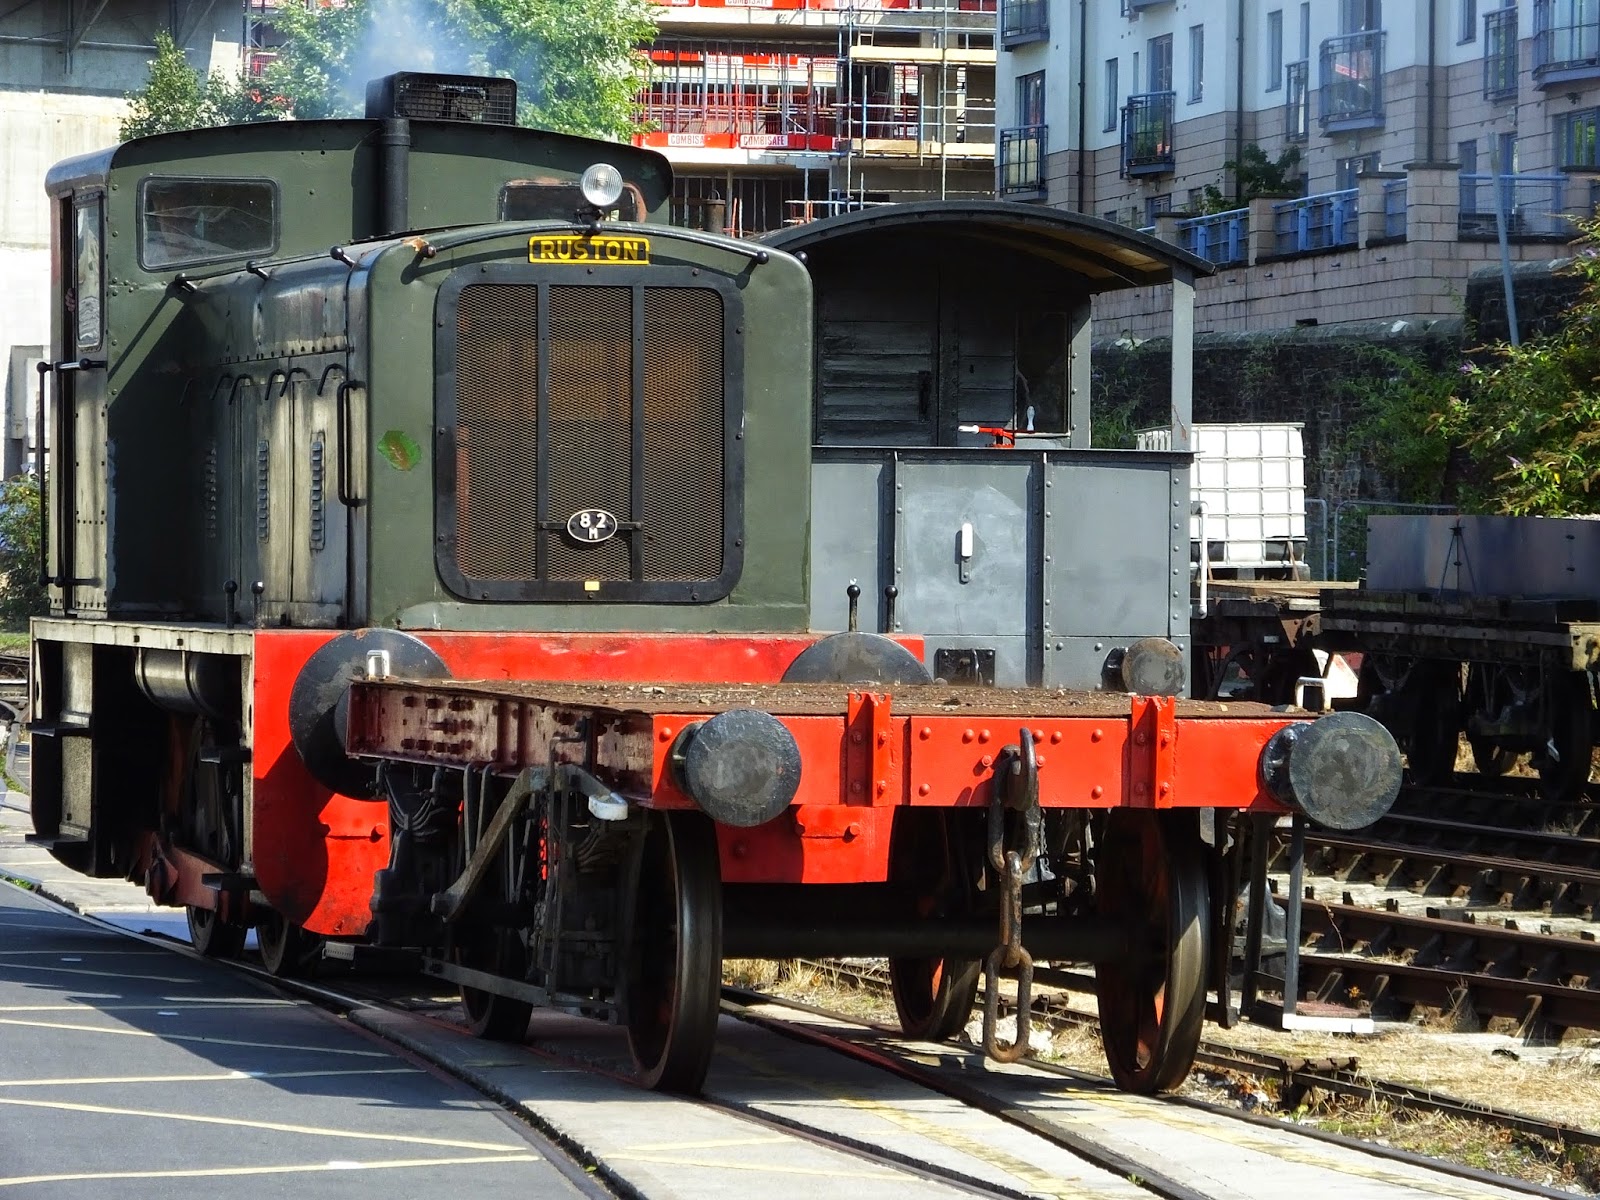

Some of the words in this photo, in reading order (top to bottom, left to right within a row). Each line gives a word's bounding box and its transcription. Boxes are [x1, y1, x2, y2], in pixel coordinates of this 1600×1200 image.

[743, 135, 784, 146] COMBISAFE
[540, 240, 638, 260] RUSTON
[589, 528, 598, 539] M
